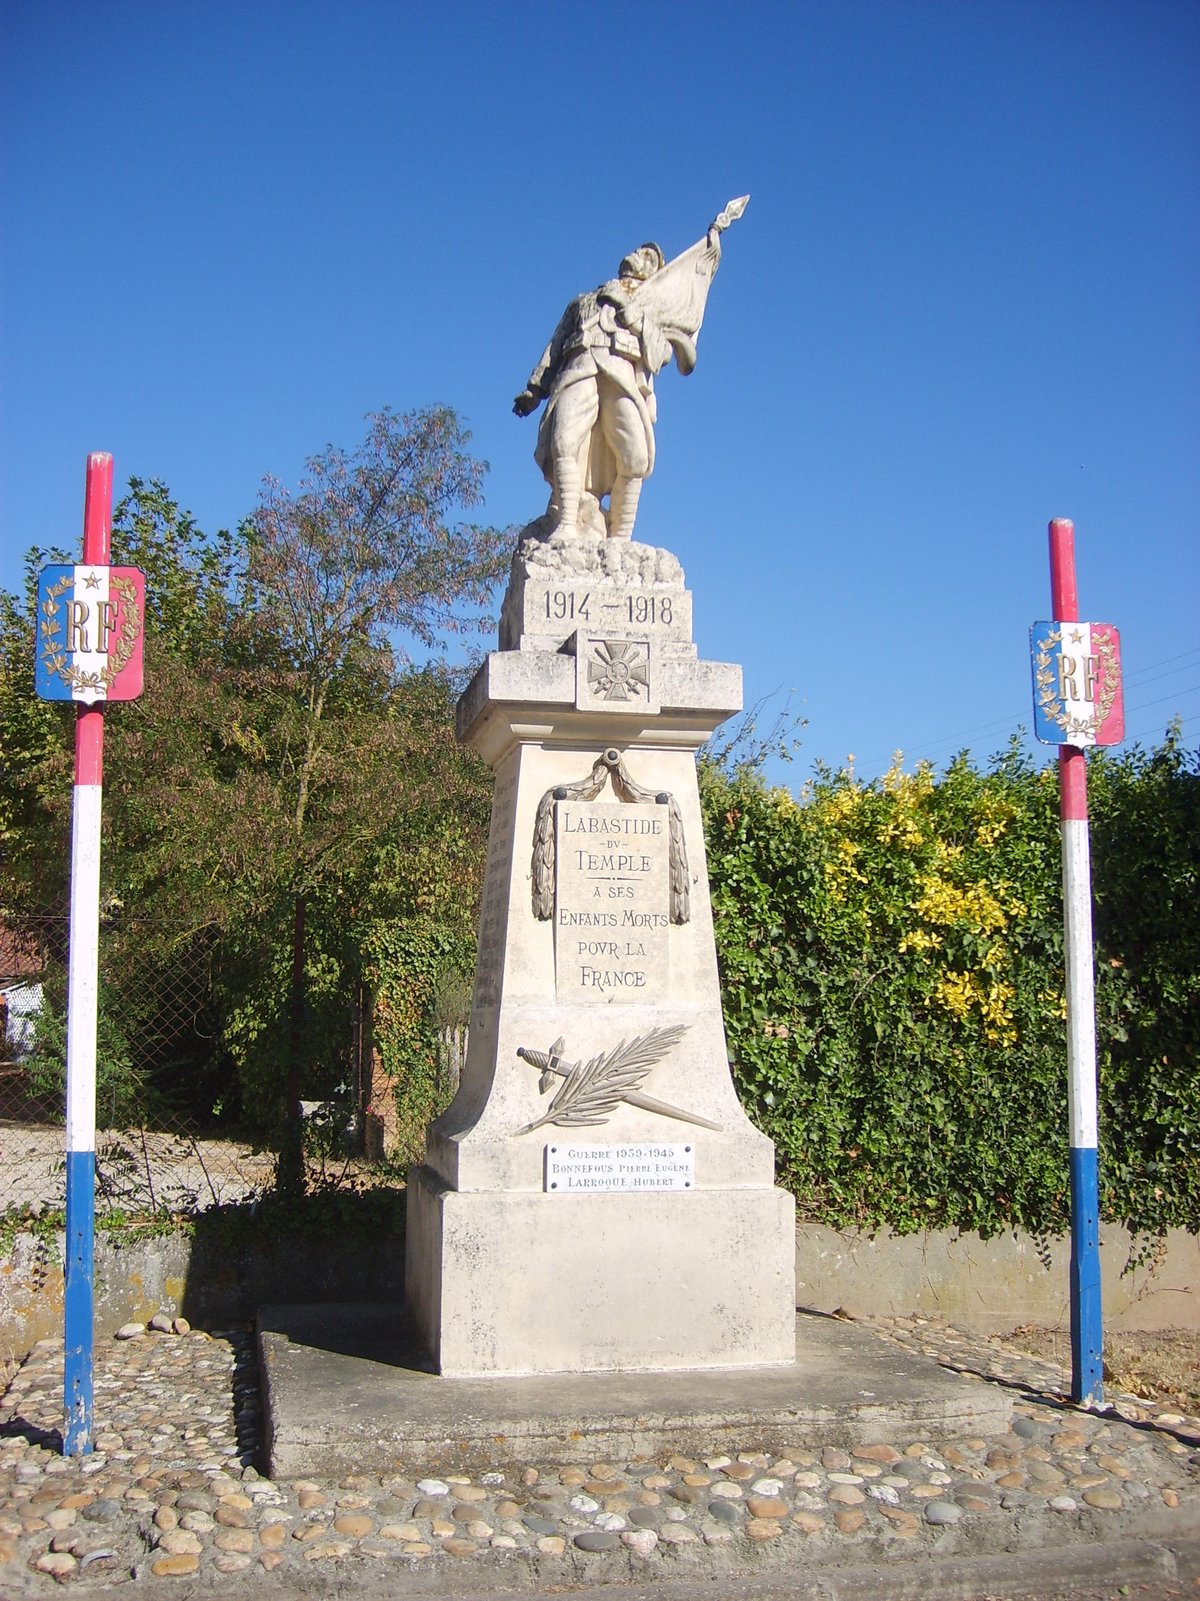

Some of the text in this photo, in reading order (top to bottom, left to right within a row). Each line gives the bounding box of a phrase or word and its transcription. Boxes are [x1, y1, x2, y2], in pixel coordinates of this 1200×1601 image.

[544, 590, 591, 621] 1914
[627, 595, 673, 624] 1918
[65, 600, 119, 653] RF
[1056, 653, 1100, 702] RF
[564, 812, 662, 835] LABASTIDE
[574, 850, 651, 872] TEMPLE
[593, 886, 634, 898] A SES
[559, 908, 669, 931] ENFANTS MORTS
[626, 942, 647, 956] LA
[580, 965, 646, 992] FRANCE
[568, 1148, 674, 1159] GUERRE 1939-1945
[552, 1163, 613, 1174] BONNEFOUS
[634, 1177, 673, 1186] HUBERT
